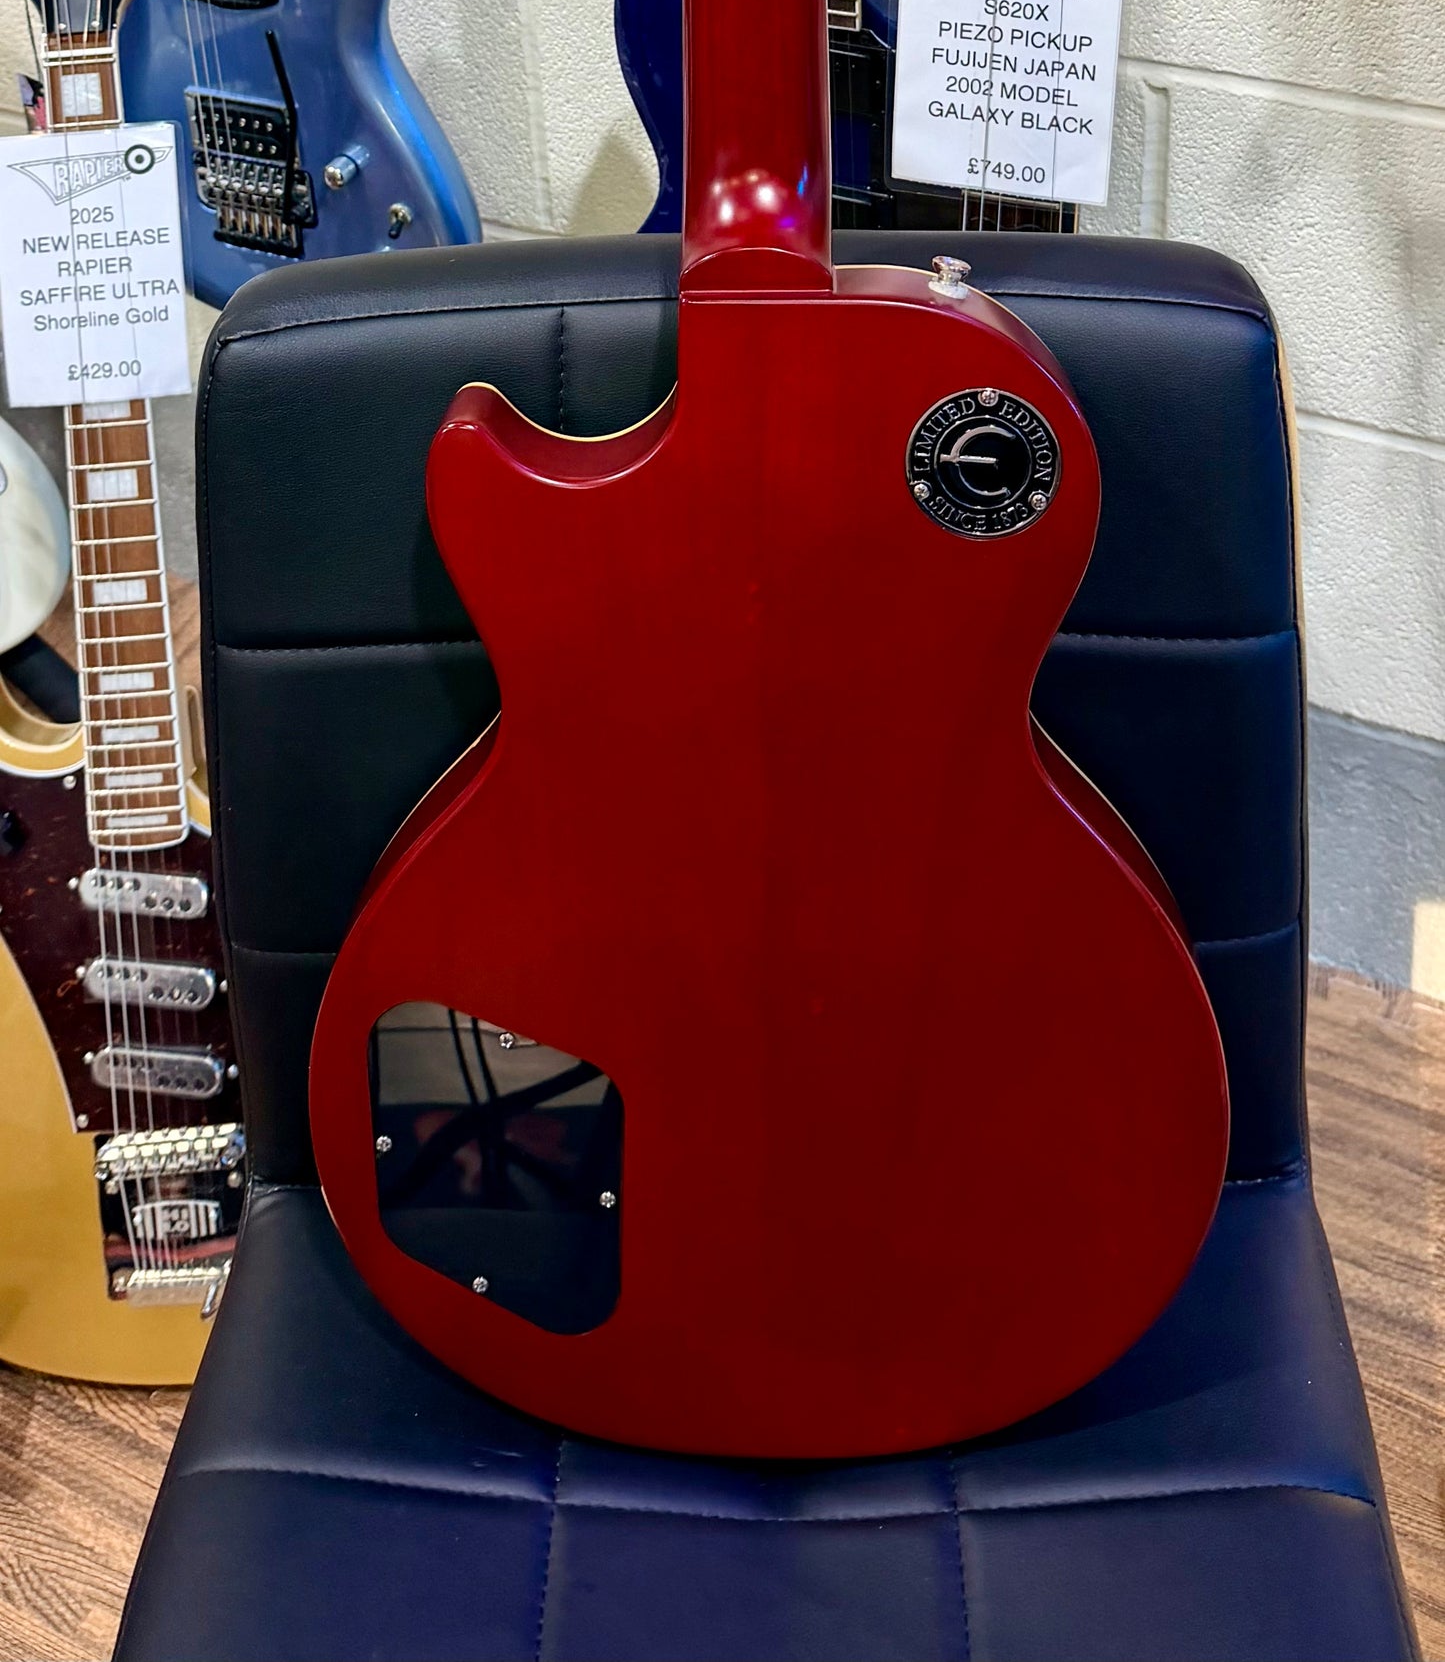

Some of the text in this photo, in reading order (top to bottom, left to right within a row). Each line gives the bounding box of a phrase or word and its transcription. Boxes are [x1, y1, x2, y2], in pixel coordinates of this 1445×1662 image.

[939, 21, 1093, 53] PIEZO PICKUP
[931, 48, 1096, 81] FUJIJEN JAPAN
[945, 75, 1078, 107] 2002 MODEL
[928, 101, 1093, 135] GALAXY BLACK
[54, 155, 125, 198] RAPIER
[967, 157, 1046, 184] £749.00
[70, 206, 114, 224] 2025
[23, 227, 170, 254] NEW RELEASE
[58, 256, 132, 277] RAPIER
[20, 278, 180, 306] SAFFIRE ULTRA
[33, 306, 169, 331] Shoreline Gold
[67, 360, 142, 381] £429.00
[914, 398, 1053, 481] LIMITED EDITION
[929, 496, 987, 530] SINCE
